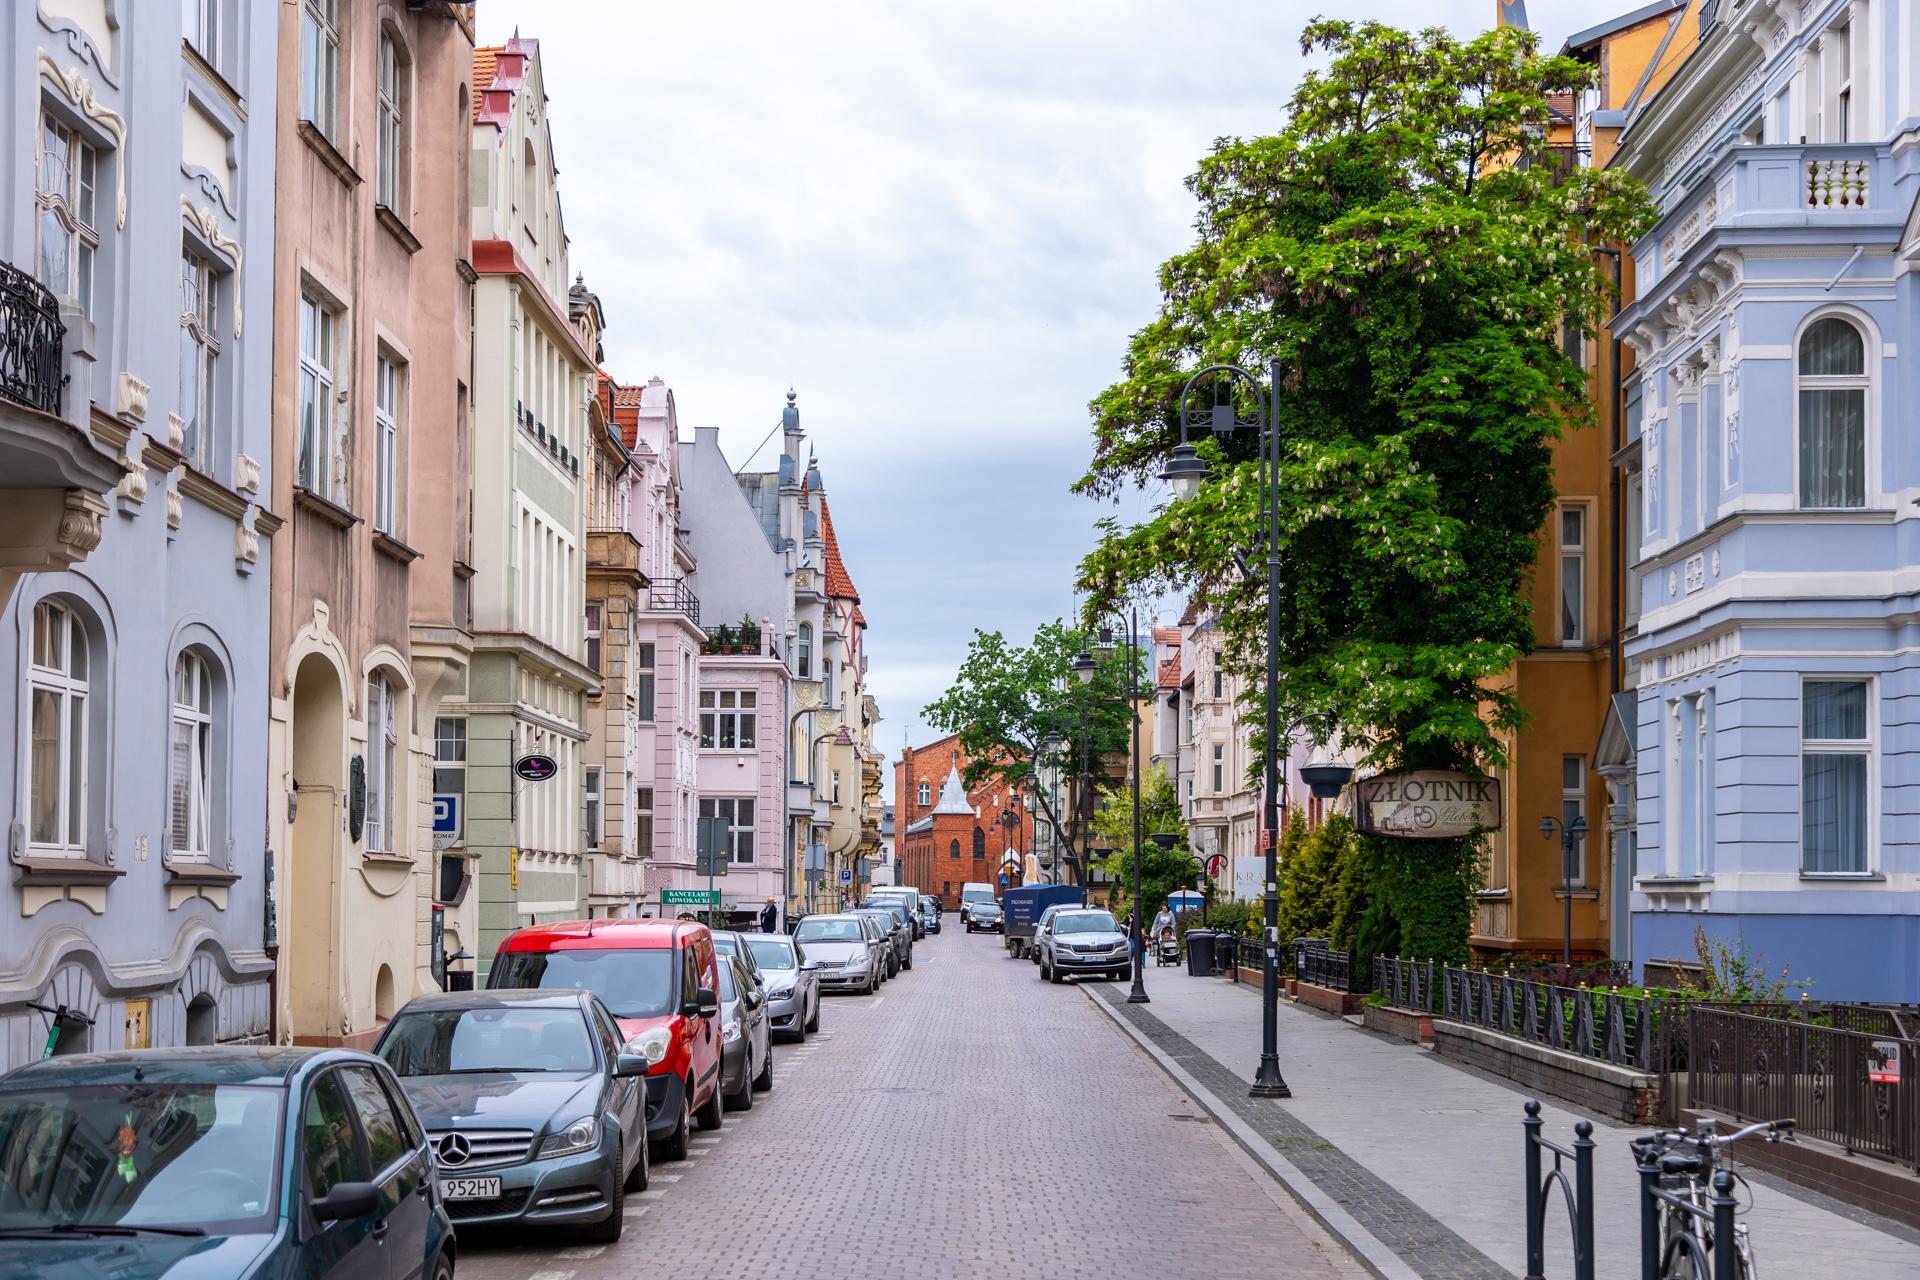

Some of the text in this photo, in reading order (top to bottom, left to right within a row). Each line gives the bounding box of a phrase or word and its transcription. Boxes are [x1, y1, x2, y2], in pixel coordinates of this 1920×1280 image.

[1369, 780, 1493, 802] ZŁOTNIK
[433, 801, 449, 827] P
[1236, 871, 1265, 881] KRA
[447, 1179, 498, 1196] 952HY
